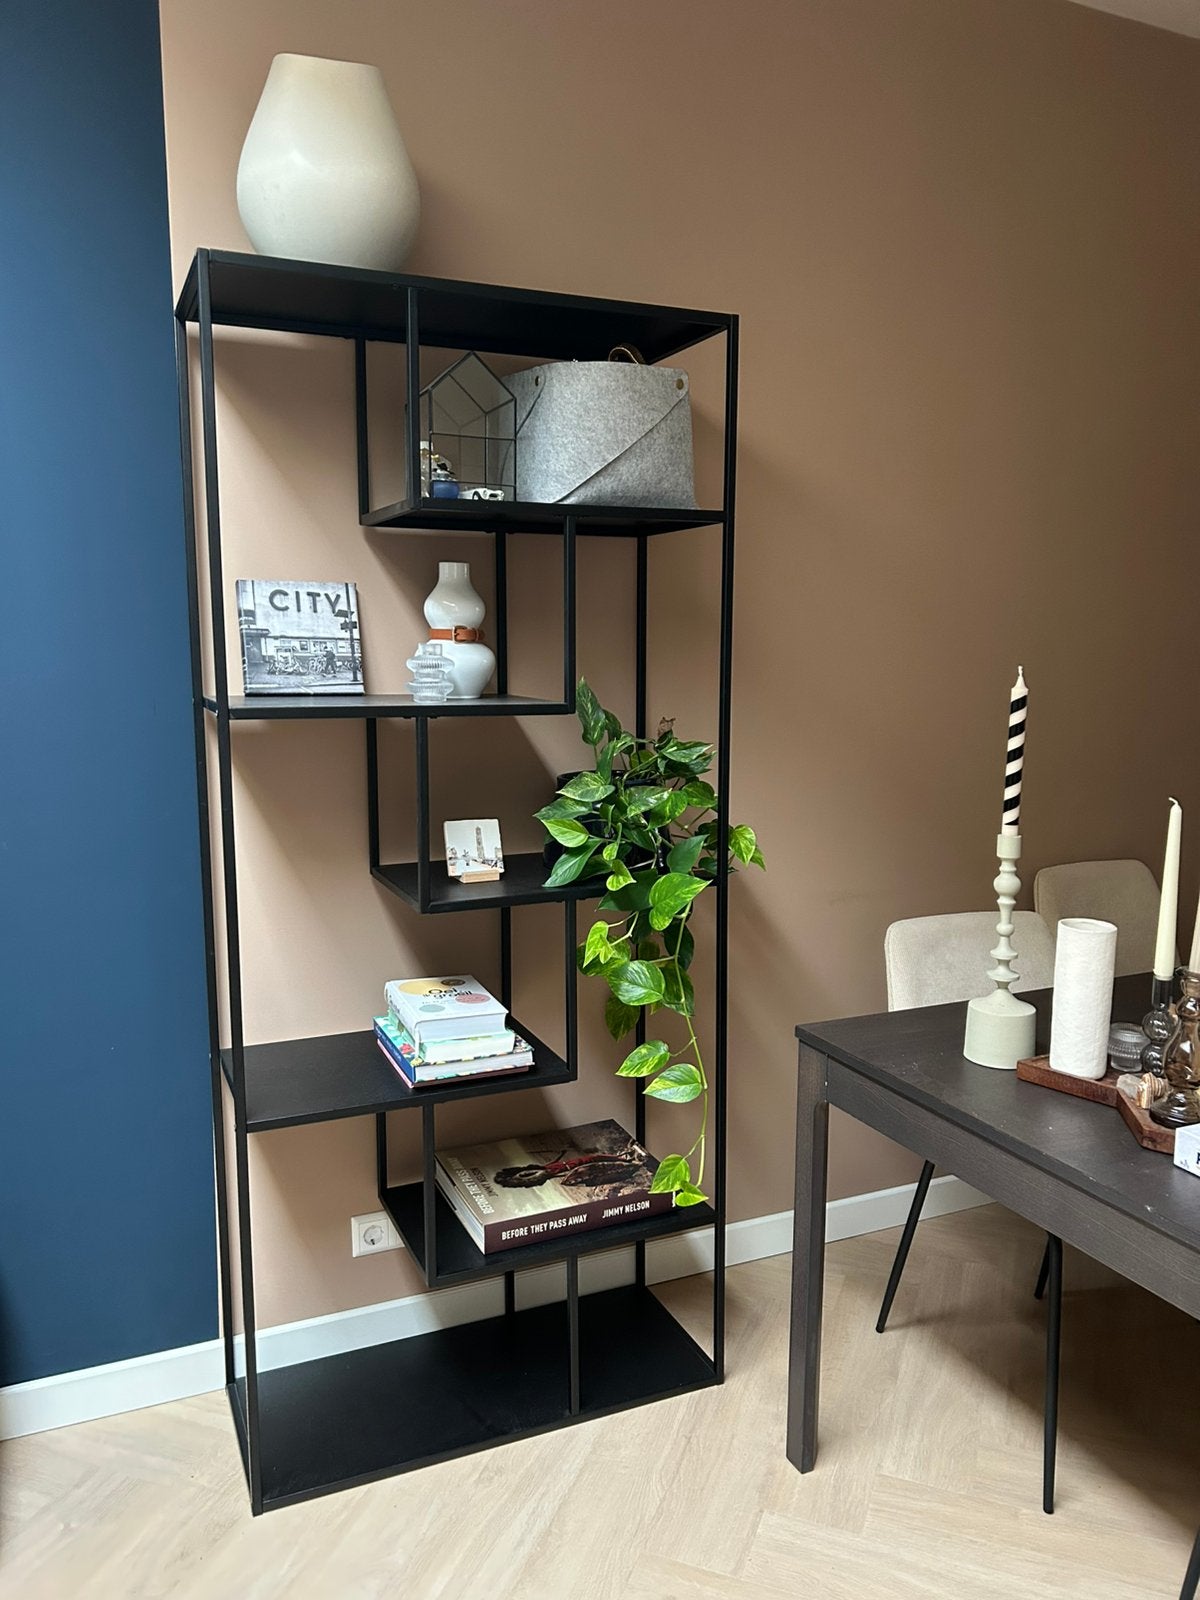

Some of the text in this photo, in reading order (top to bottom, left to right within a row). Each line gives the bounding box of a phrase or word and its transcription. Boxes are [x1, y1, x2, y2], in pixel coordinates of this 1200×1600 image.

[269, 589, 341, 614] CITY
[464, 1182, 482, 1195] THEY
[473, 1194, 495, 1214] BEFORE
[602, 1201, 650, 1219] JIMMY NELSON
[502, 1214, 588, 1241] BEFORE THEY PASS AWAY
